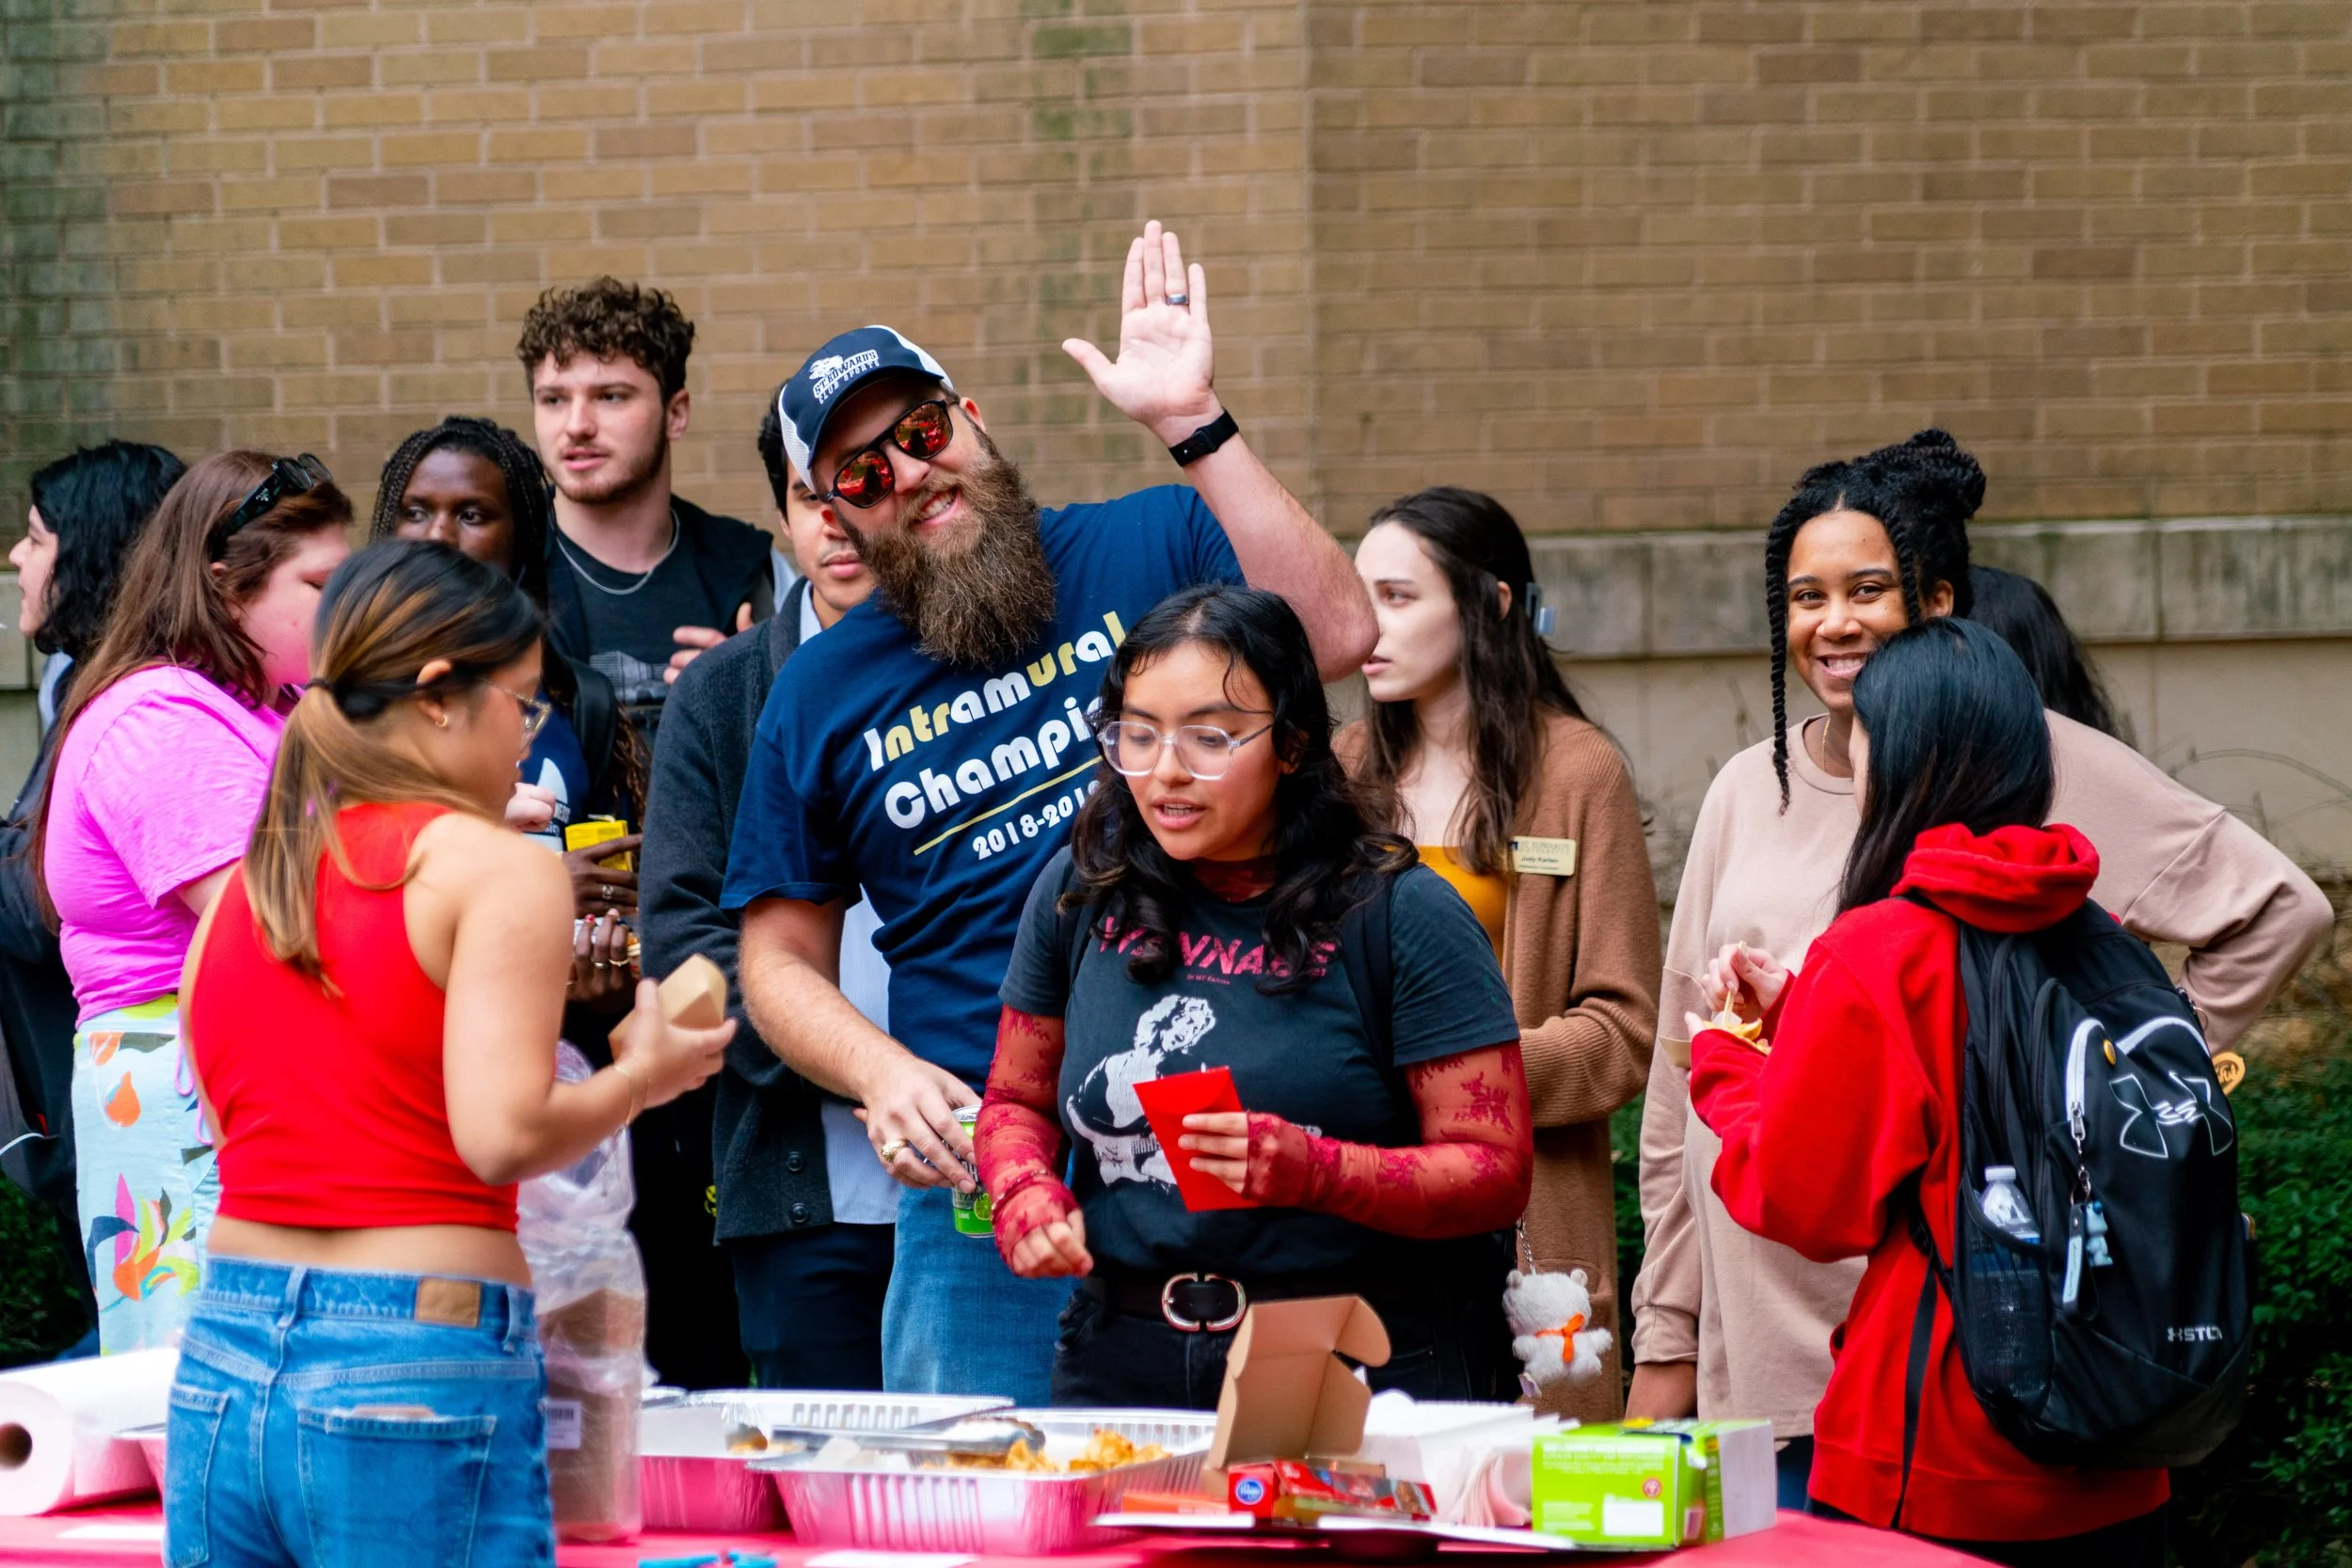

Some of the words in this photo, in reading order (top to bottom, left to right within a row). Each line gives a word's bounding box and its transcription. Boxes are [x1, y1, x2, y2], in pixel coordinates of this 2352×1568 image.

[818, 382, 839, 404] CLUB
[843, 360, 880, 382] SPORTS
[864, 610, 1126, 771] Intramural
